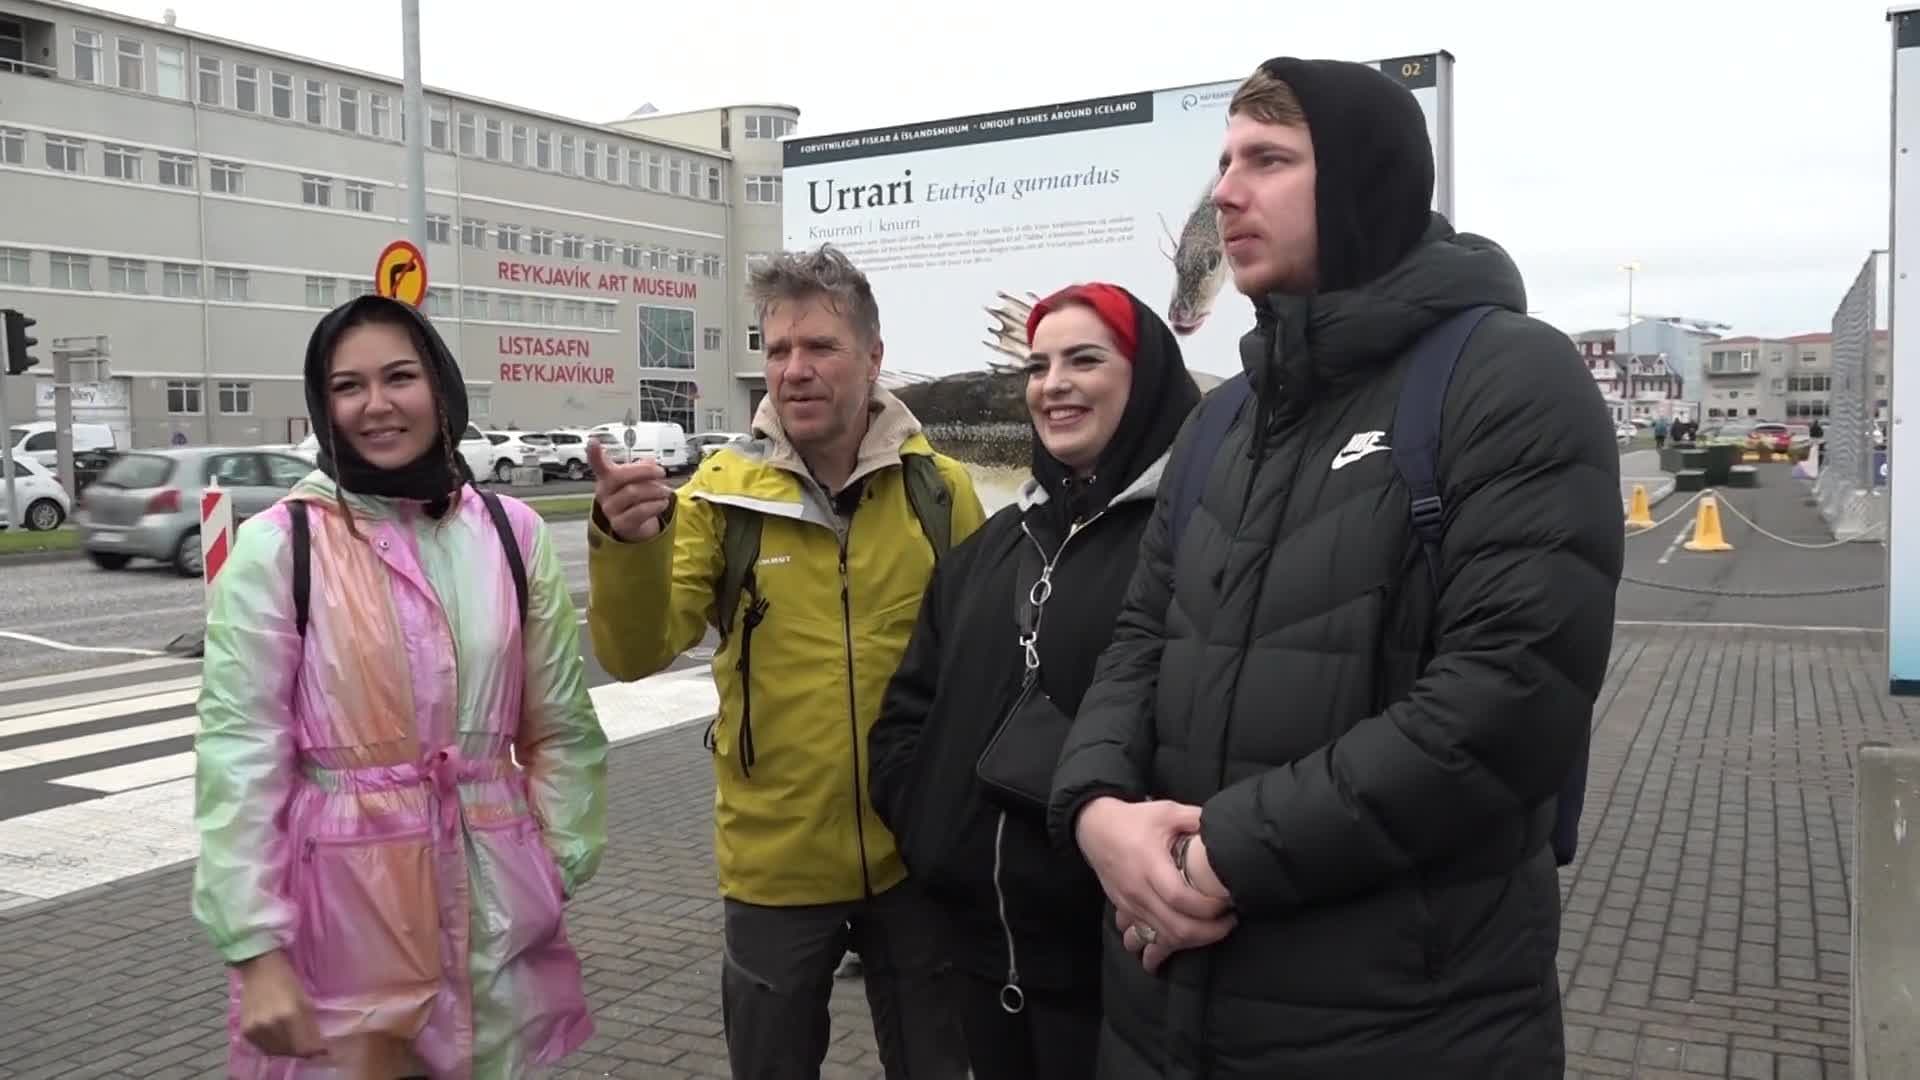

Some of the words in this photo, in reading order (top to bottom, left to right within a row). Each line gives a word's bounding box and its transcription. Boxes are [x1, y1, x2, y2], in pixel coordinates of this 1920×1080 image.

[862, 135, 891, 145] FISKAR
[980, 118, 1014, 130] UNIQUE
[1017, 114, 1049, 125] FISHES
[1051, 107, 1092, 120] AROUND
[1095, 101, 1137, 115] ICELAND
[808, 169, 913, 214] Urrari
[926, 179, 1006, 204] Eutrigla
[1012, 165, 1120, 199] gurnardus
[808, 222, 863, 240] Knurrari
[879, 215, 921, 233] knurri
[497, 261, 591, 288] REYKJAVÍK
[598, 274, 628, 293] ART
[633, 278, 697, 300] MUSEUM
[498, 335, 590, 358] LISTASAFN
[499, 361, 615, 385] REYKJAVÍKUR
